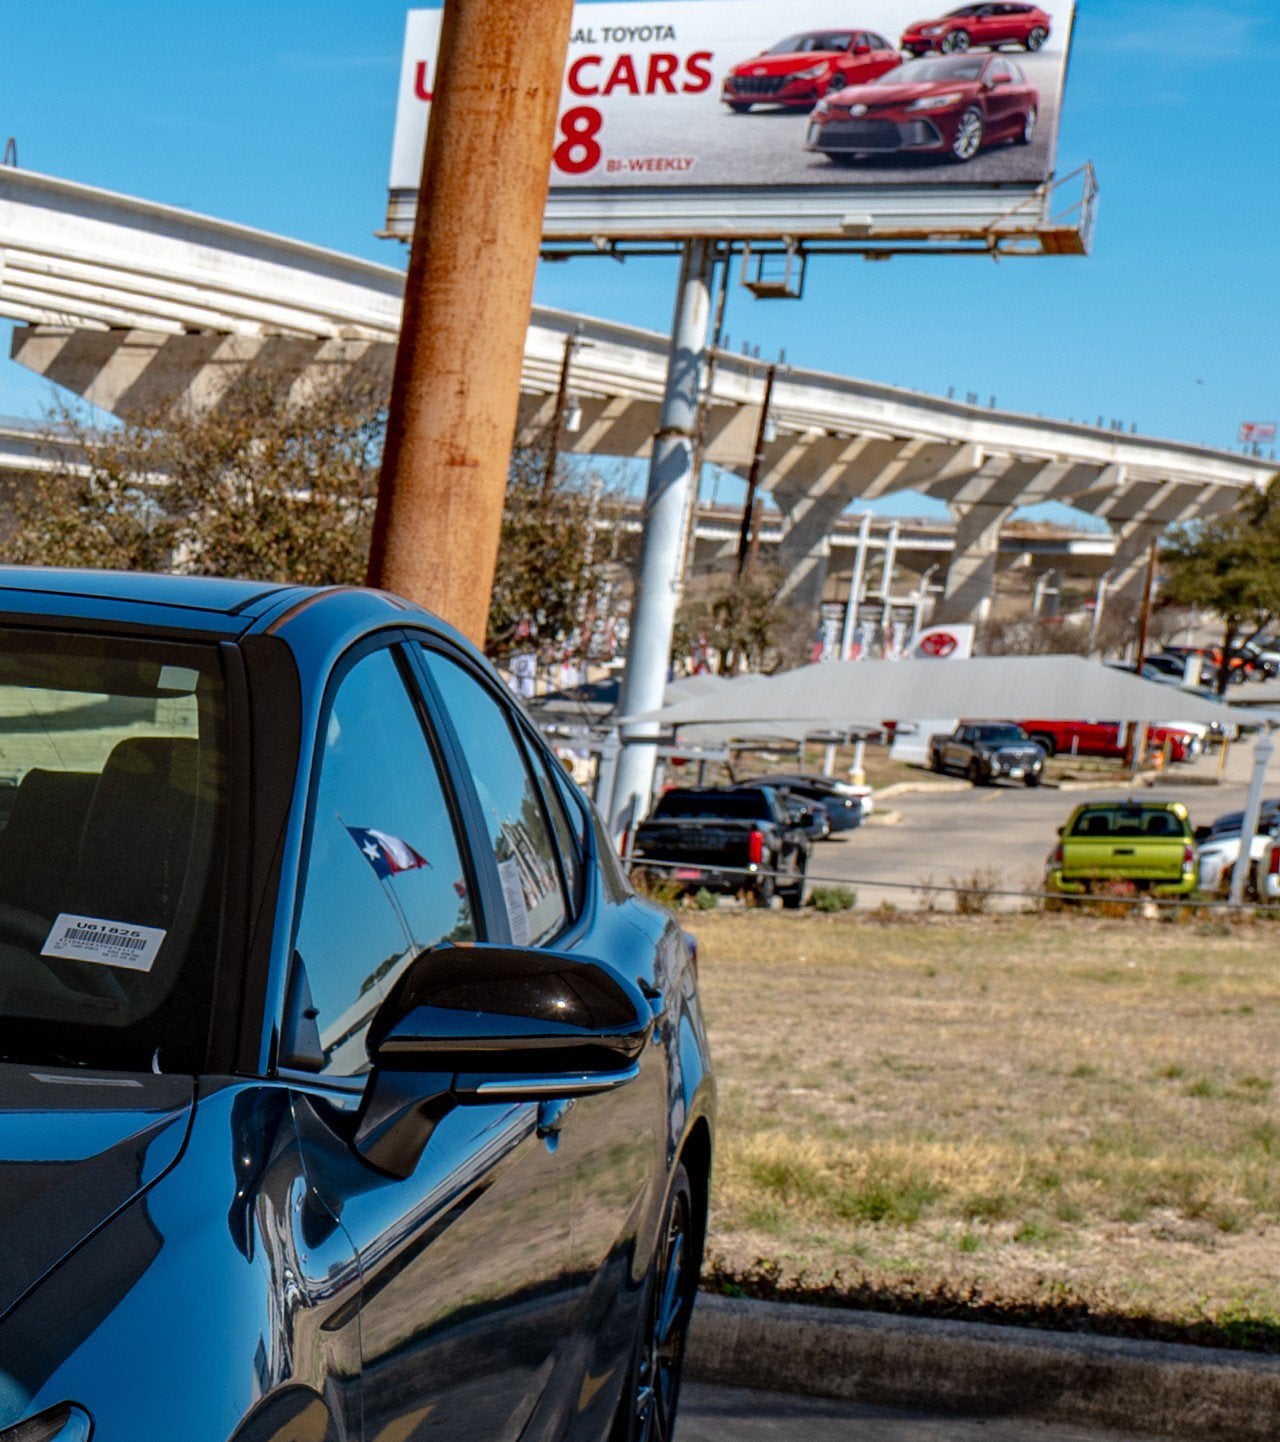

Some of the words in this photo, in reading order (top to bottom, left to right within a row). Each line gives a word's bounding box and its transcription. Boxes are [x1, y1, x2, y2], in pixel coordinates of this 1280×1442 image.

[601, 25, 677, 42] TOYOTA
[567, 51, 713, 97] CARS
[606, 157, 694, 173] BI-WEEKLY
